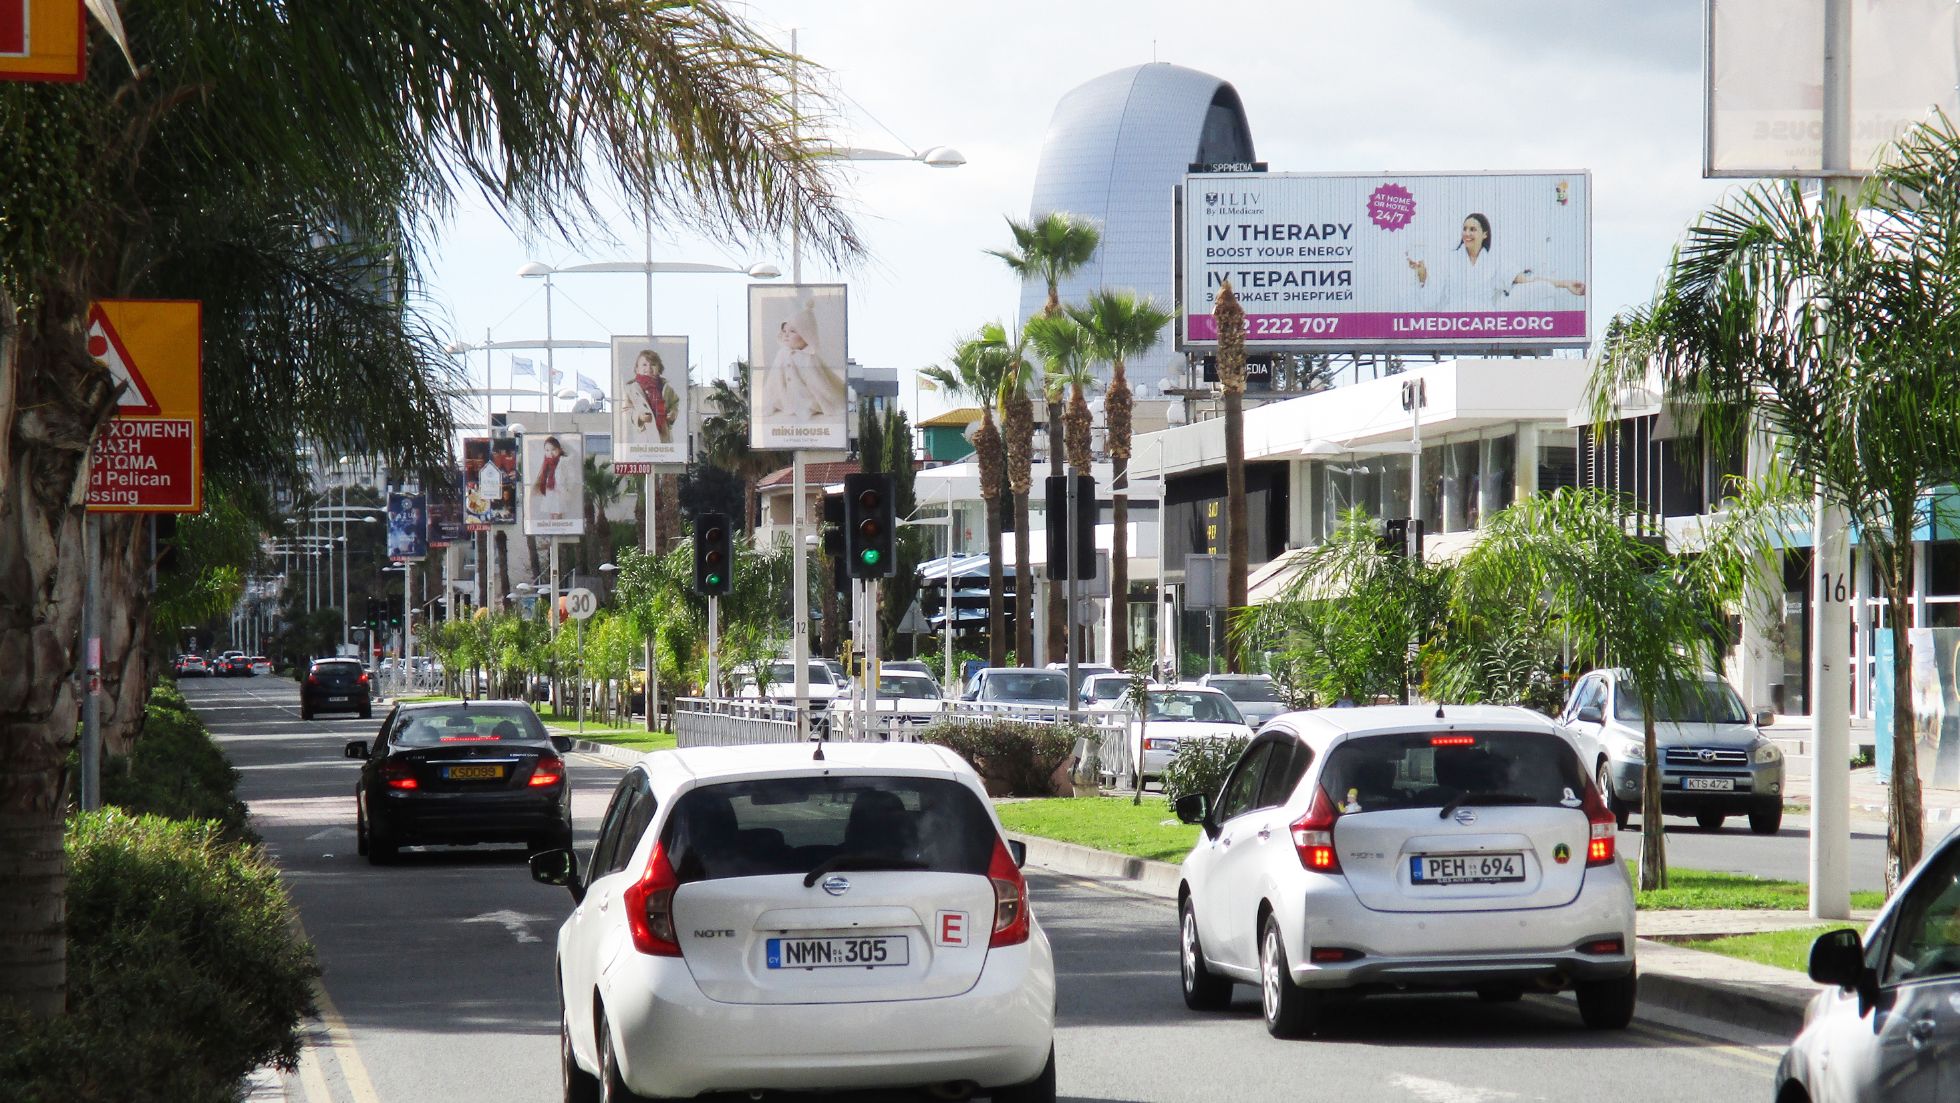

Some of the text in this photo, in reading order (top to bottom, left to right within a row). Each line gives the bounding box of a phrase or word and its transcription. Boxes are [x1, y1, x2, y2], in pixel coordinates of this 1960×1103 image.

[1212, 163, 1253, 172] SPPMEDIA
[1386, 202, 1409, 211] HOTEL
[1387, 195, 1411, 204] HOME
[1206, 208, 1216, 216] By
[1376, 209, 1404, 223] 24/7
[1207, 223, 1353, 240] IV THERAPY
[1206, 246, 1353, 257] BOOST YOUR ENERGY
[1237, 270, 1352, 287] ТЕРАПИЯ
[1206, 289, 1353, 301] ЗЯЖАЕТ ЭНЕРГИЕЙ
[1257, 318, 1293, 334] 222
[1300, 317, 1339, 333] 707
[1393, 316, 1554, 332] ILMEDICARE.ORG
[796, 427, 831, 436] HOUSE
[106, 471, 171, 486] Pelican
[1822, 572, 1846, 603] 16
[572, 594, 590, 613] 30
[796, 622, 806, 634] 12
[1688, 779, 1729, 789] KTS 472
[1429, 857, 1514, 877] PEH 694
[694, 929, 736, 938] NOTE
[942, 914, 962, 944] E
[786, 940, 888, 964] NMN 305
